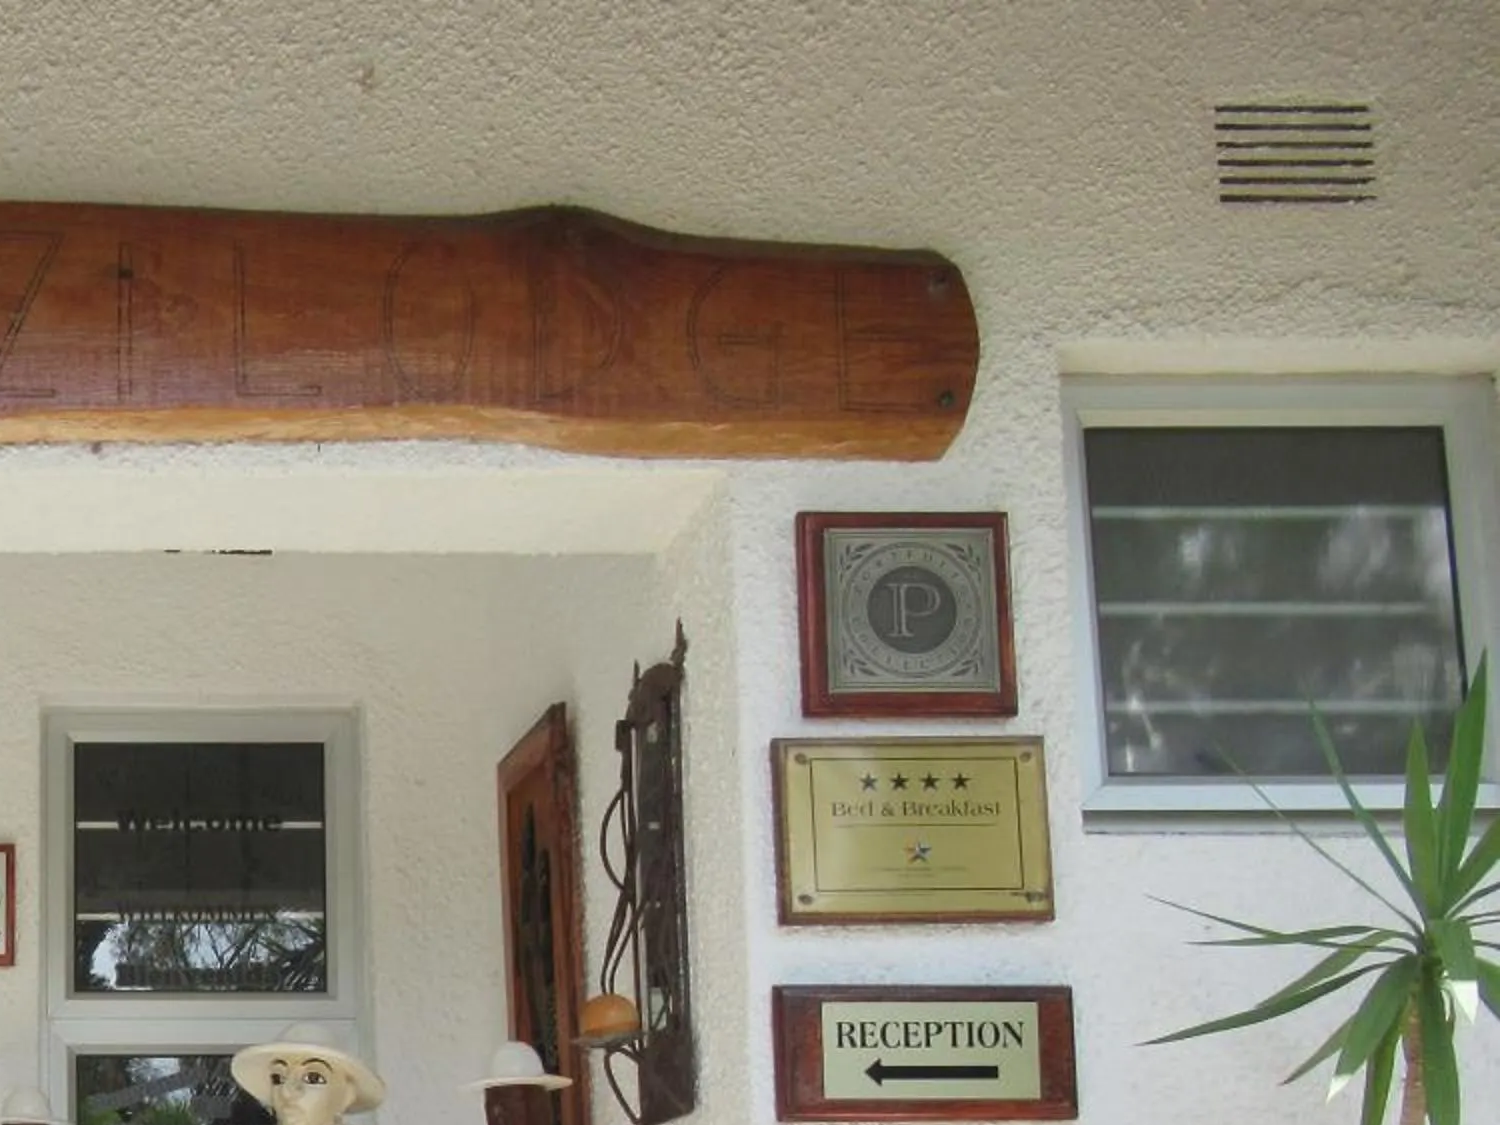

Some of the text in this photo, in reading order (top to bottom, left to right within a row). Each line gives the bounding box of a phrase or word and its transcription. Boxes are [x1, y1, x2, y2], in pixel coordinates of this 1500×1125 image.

[232, 238, 932, 413] LODGE
[881, 581, 942, 639] P
[831, 799, 1003, 819] Bed & Breakfast
[835, 1020, 1026, 1049] RECEPTION
